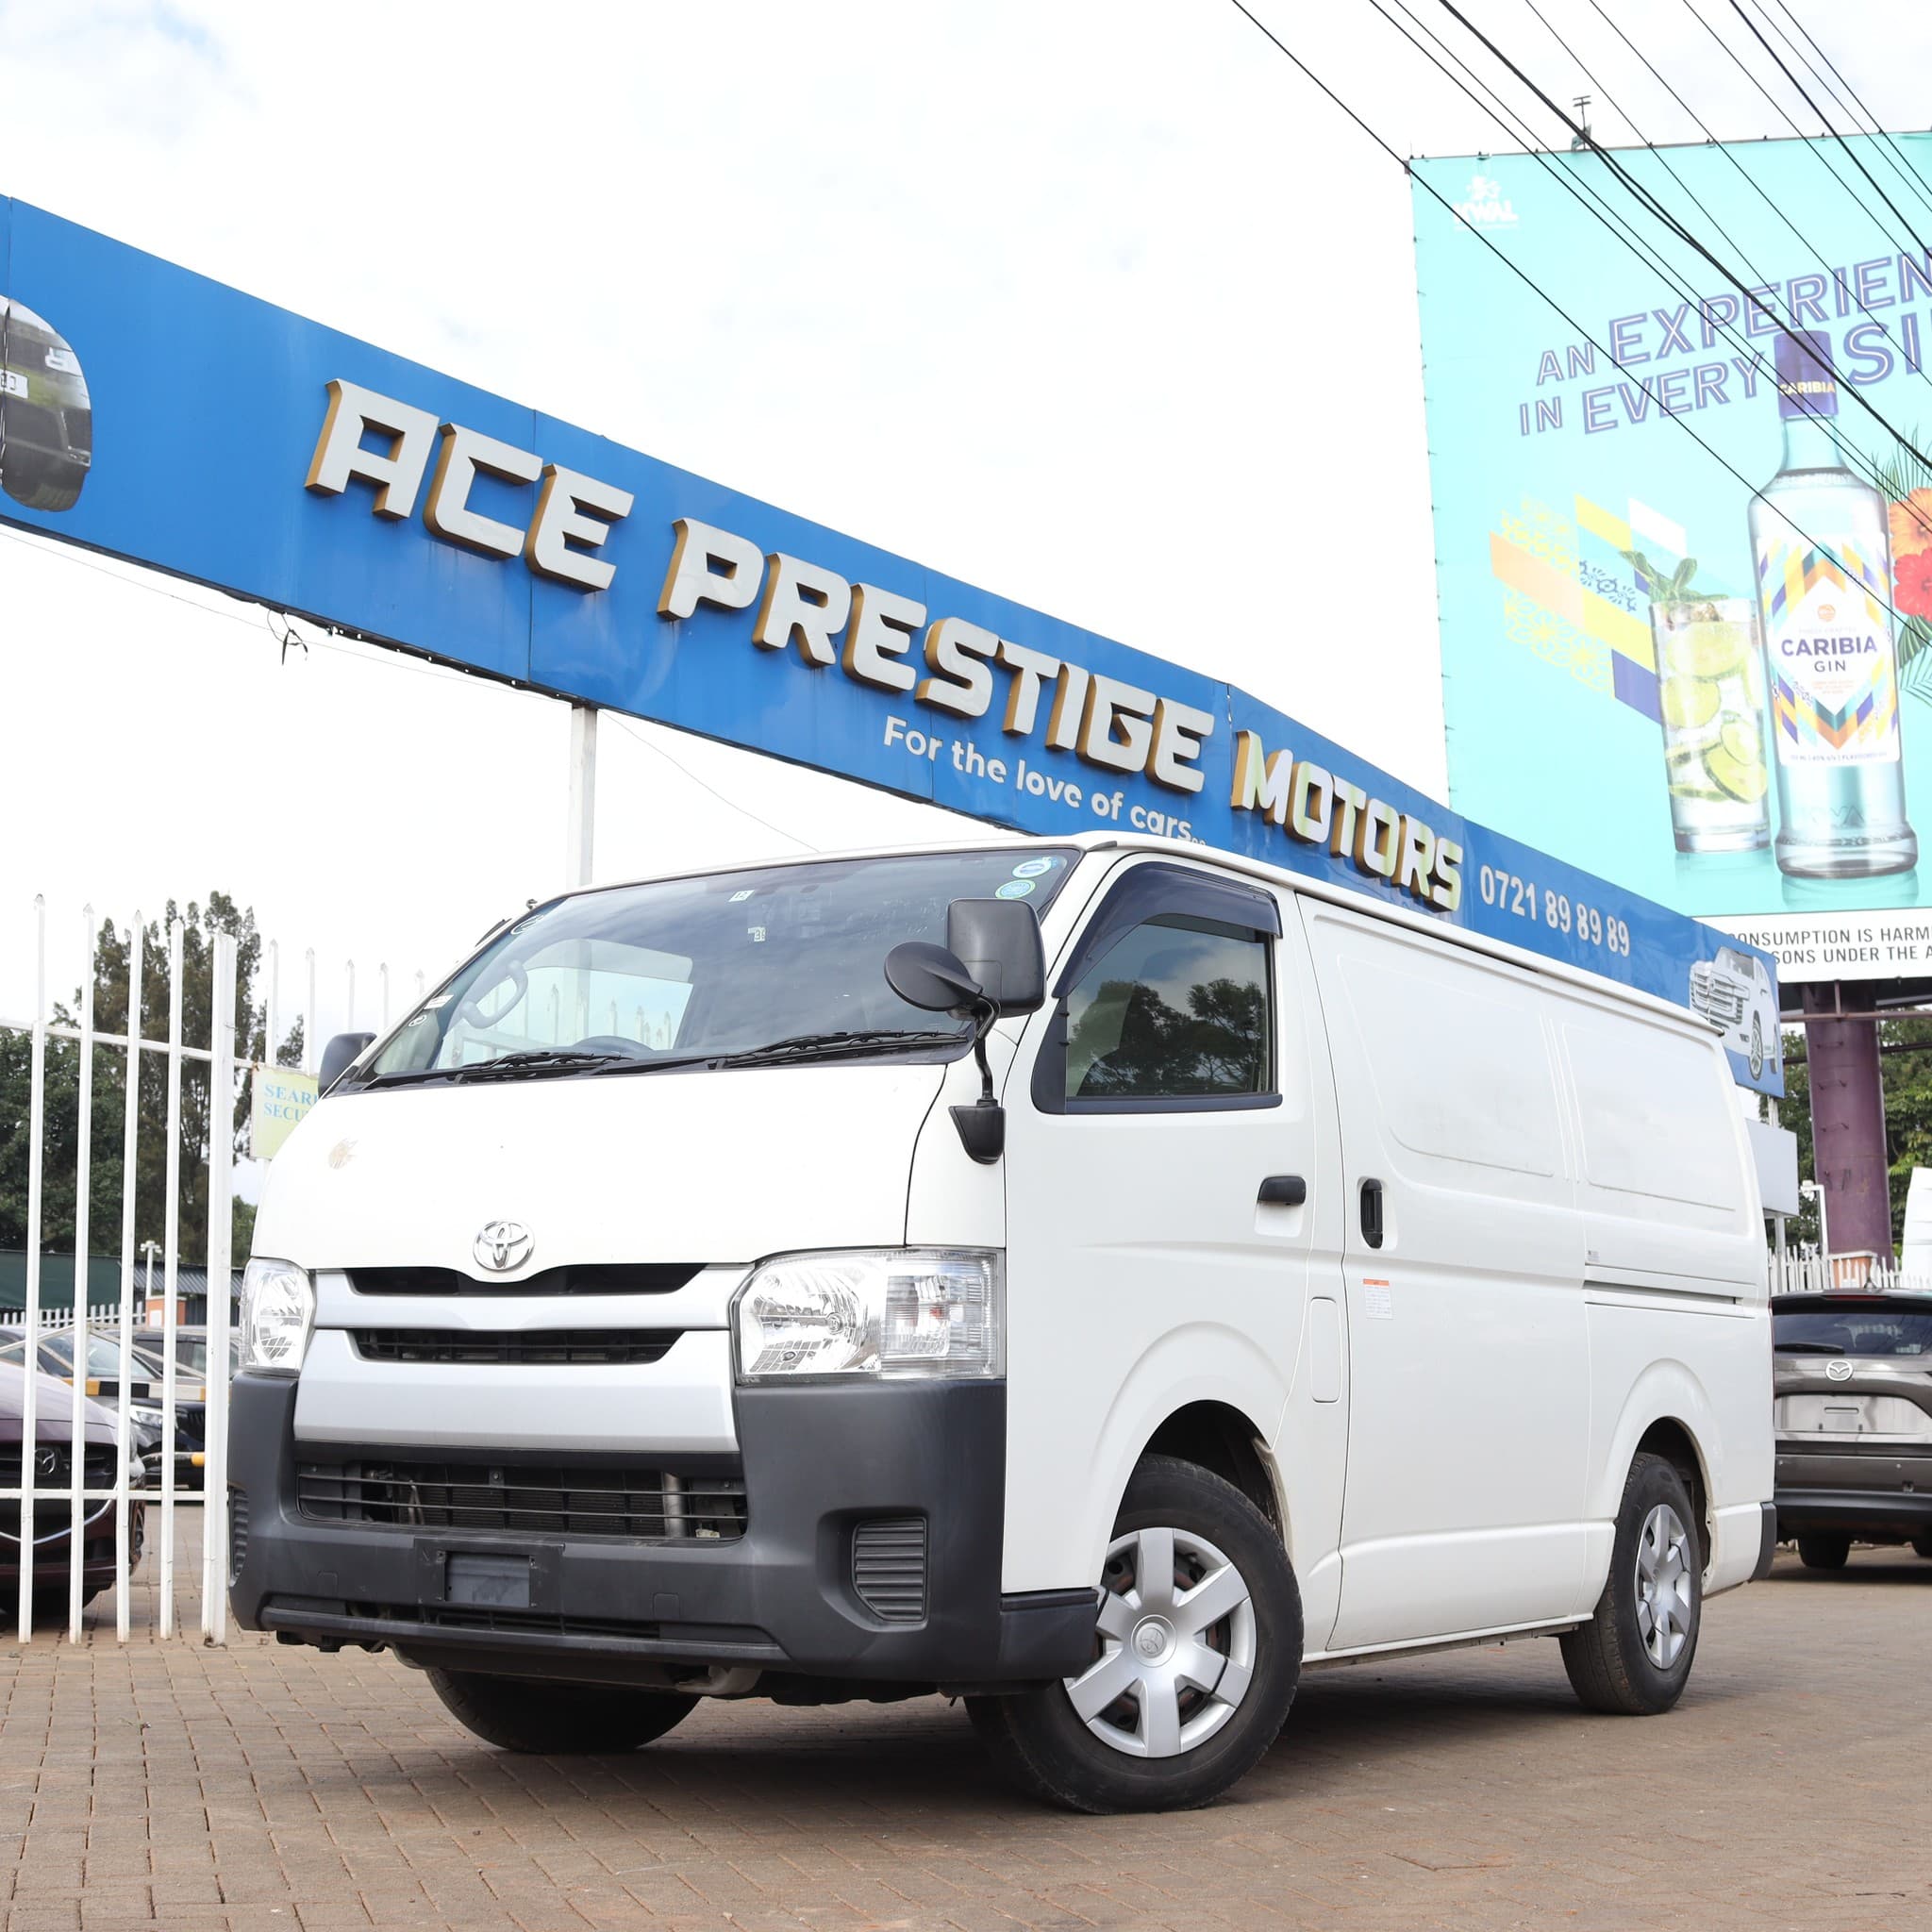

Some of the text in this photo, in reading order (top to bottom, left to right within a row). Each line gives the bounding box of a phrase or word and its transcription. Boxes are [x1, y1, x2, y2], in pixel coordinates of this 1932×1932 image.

[1519, 308, 1932, 436] IN EVERY SI
[1536, 341, 1595, 386] AN
[1779, 380, 1836, 395] CARIBIA
[305, 378, 1463, 912] ACE PRESTIGE MOTORS
[1781, 636, 1877, 657] CARIBIA
[1814, 659, 1846, 673] GIN
[883, 715, 942, 761] For
[951, 741, 1007, 784] the
[1016, 759, 1082, 808] love
[1091, 791, 1124, 821] of
[1479, 865, 1631, 958] 0721 89 89 89
[1728, 926, 1932, 946] ONSUMPTION IS HARM
[1824, 947, 1880, 963] UNDER
[1887, 945, 1918, 960] THE
[264, 1102, 308, 1122] SECU
